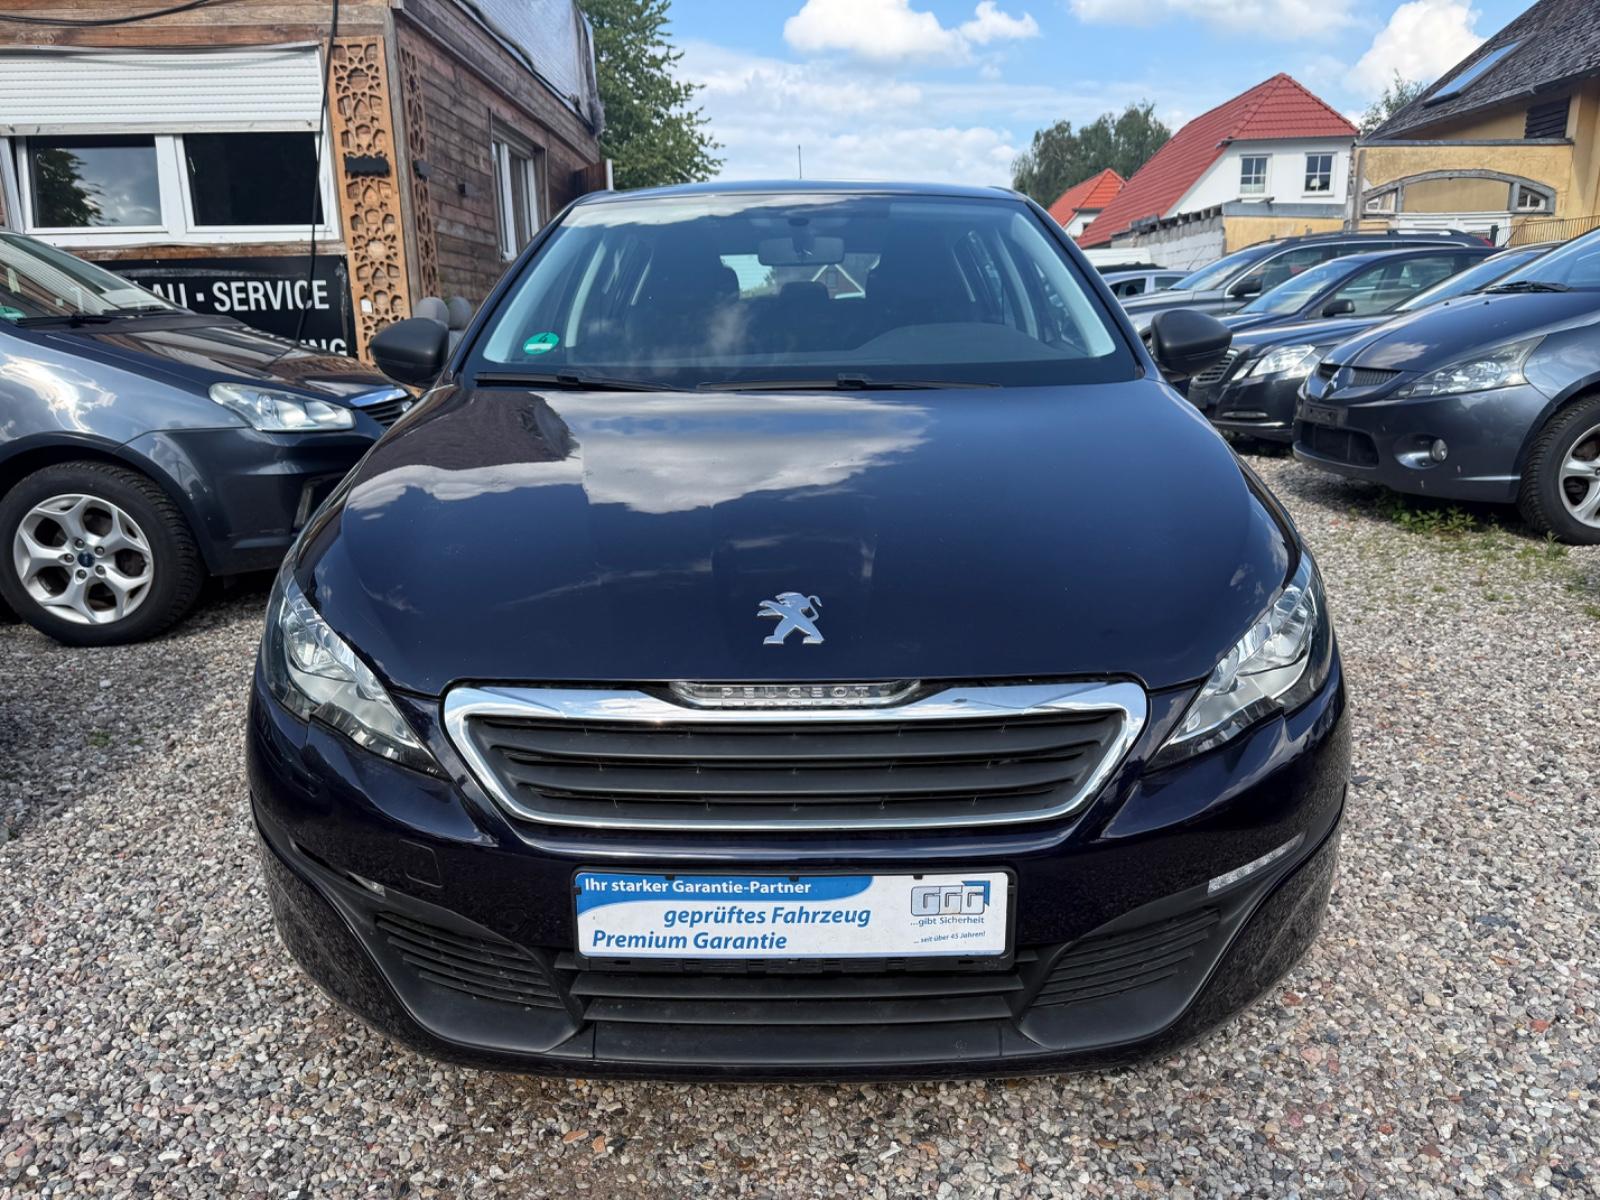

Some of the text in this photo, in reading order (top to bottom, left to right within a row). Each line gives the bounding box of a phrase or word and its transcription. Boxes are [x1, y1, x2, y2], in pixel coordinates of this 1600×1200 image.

[212, 279, 330, 312] SERVICE
[584, 878, 811, 894] Ihr starker Garantie-Partner
[664, 905, 871, 928] geprüftes Fahrzeug
[939, 916, 985, 925] Sicherheit
[592, 930, 788, 950] Premium Garantie
[960, 930, 986, 939] Jahren!
